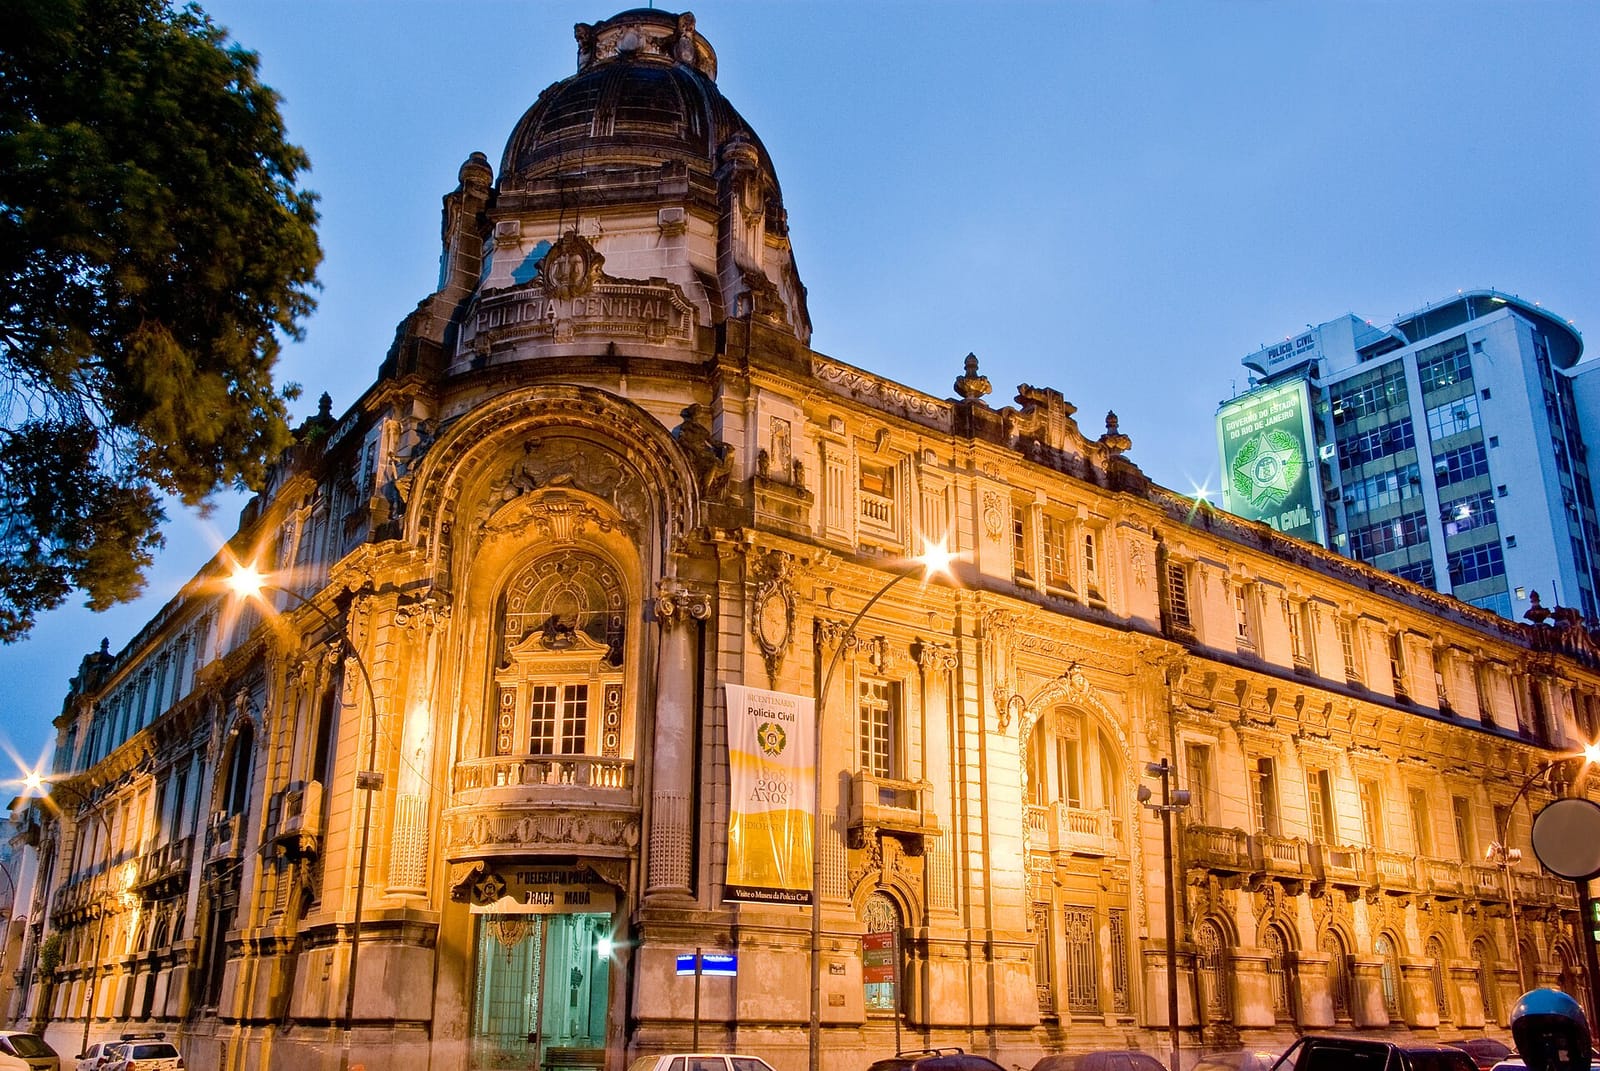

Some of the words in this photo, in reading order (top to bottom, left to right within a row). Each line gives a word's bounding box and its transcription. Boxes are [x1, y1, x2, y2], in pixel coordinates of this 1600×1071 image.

[571, 297, 669, 319] CENTRAL
[1296, 333, 1314, 348] CIVIL
[1226, 413, 1258, 431] GOVERNO
[1258, 409, 1268, 419] DO
[1269, 400, 1296, 414] ESTADO
[1230, 429, 1240, 439] DO
[1241, 424, 1253, 435] RIO
[1254, 421, 1264, 430] DE
[1265, 409, 1294, 427] JANEIRO
[1281, 507, 1310, 531] CIVIL
[777, 711, 795, 722] Civil
[754, 766, 786, 781] 1808
[750, 786, 787, 804] ANOS
[525, 891, 554, 908] PRAÇA
[564, 887, 591, 905] MAUÁ
[735, 889, 751, 898] Visite
[755, 890, 772, 899] Museu
[772, 891, 780, 900] da
[796, 893, 809, 901] Civil
